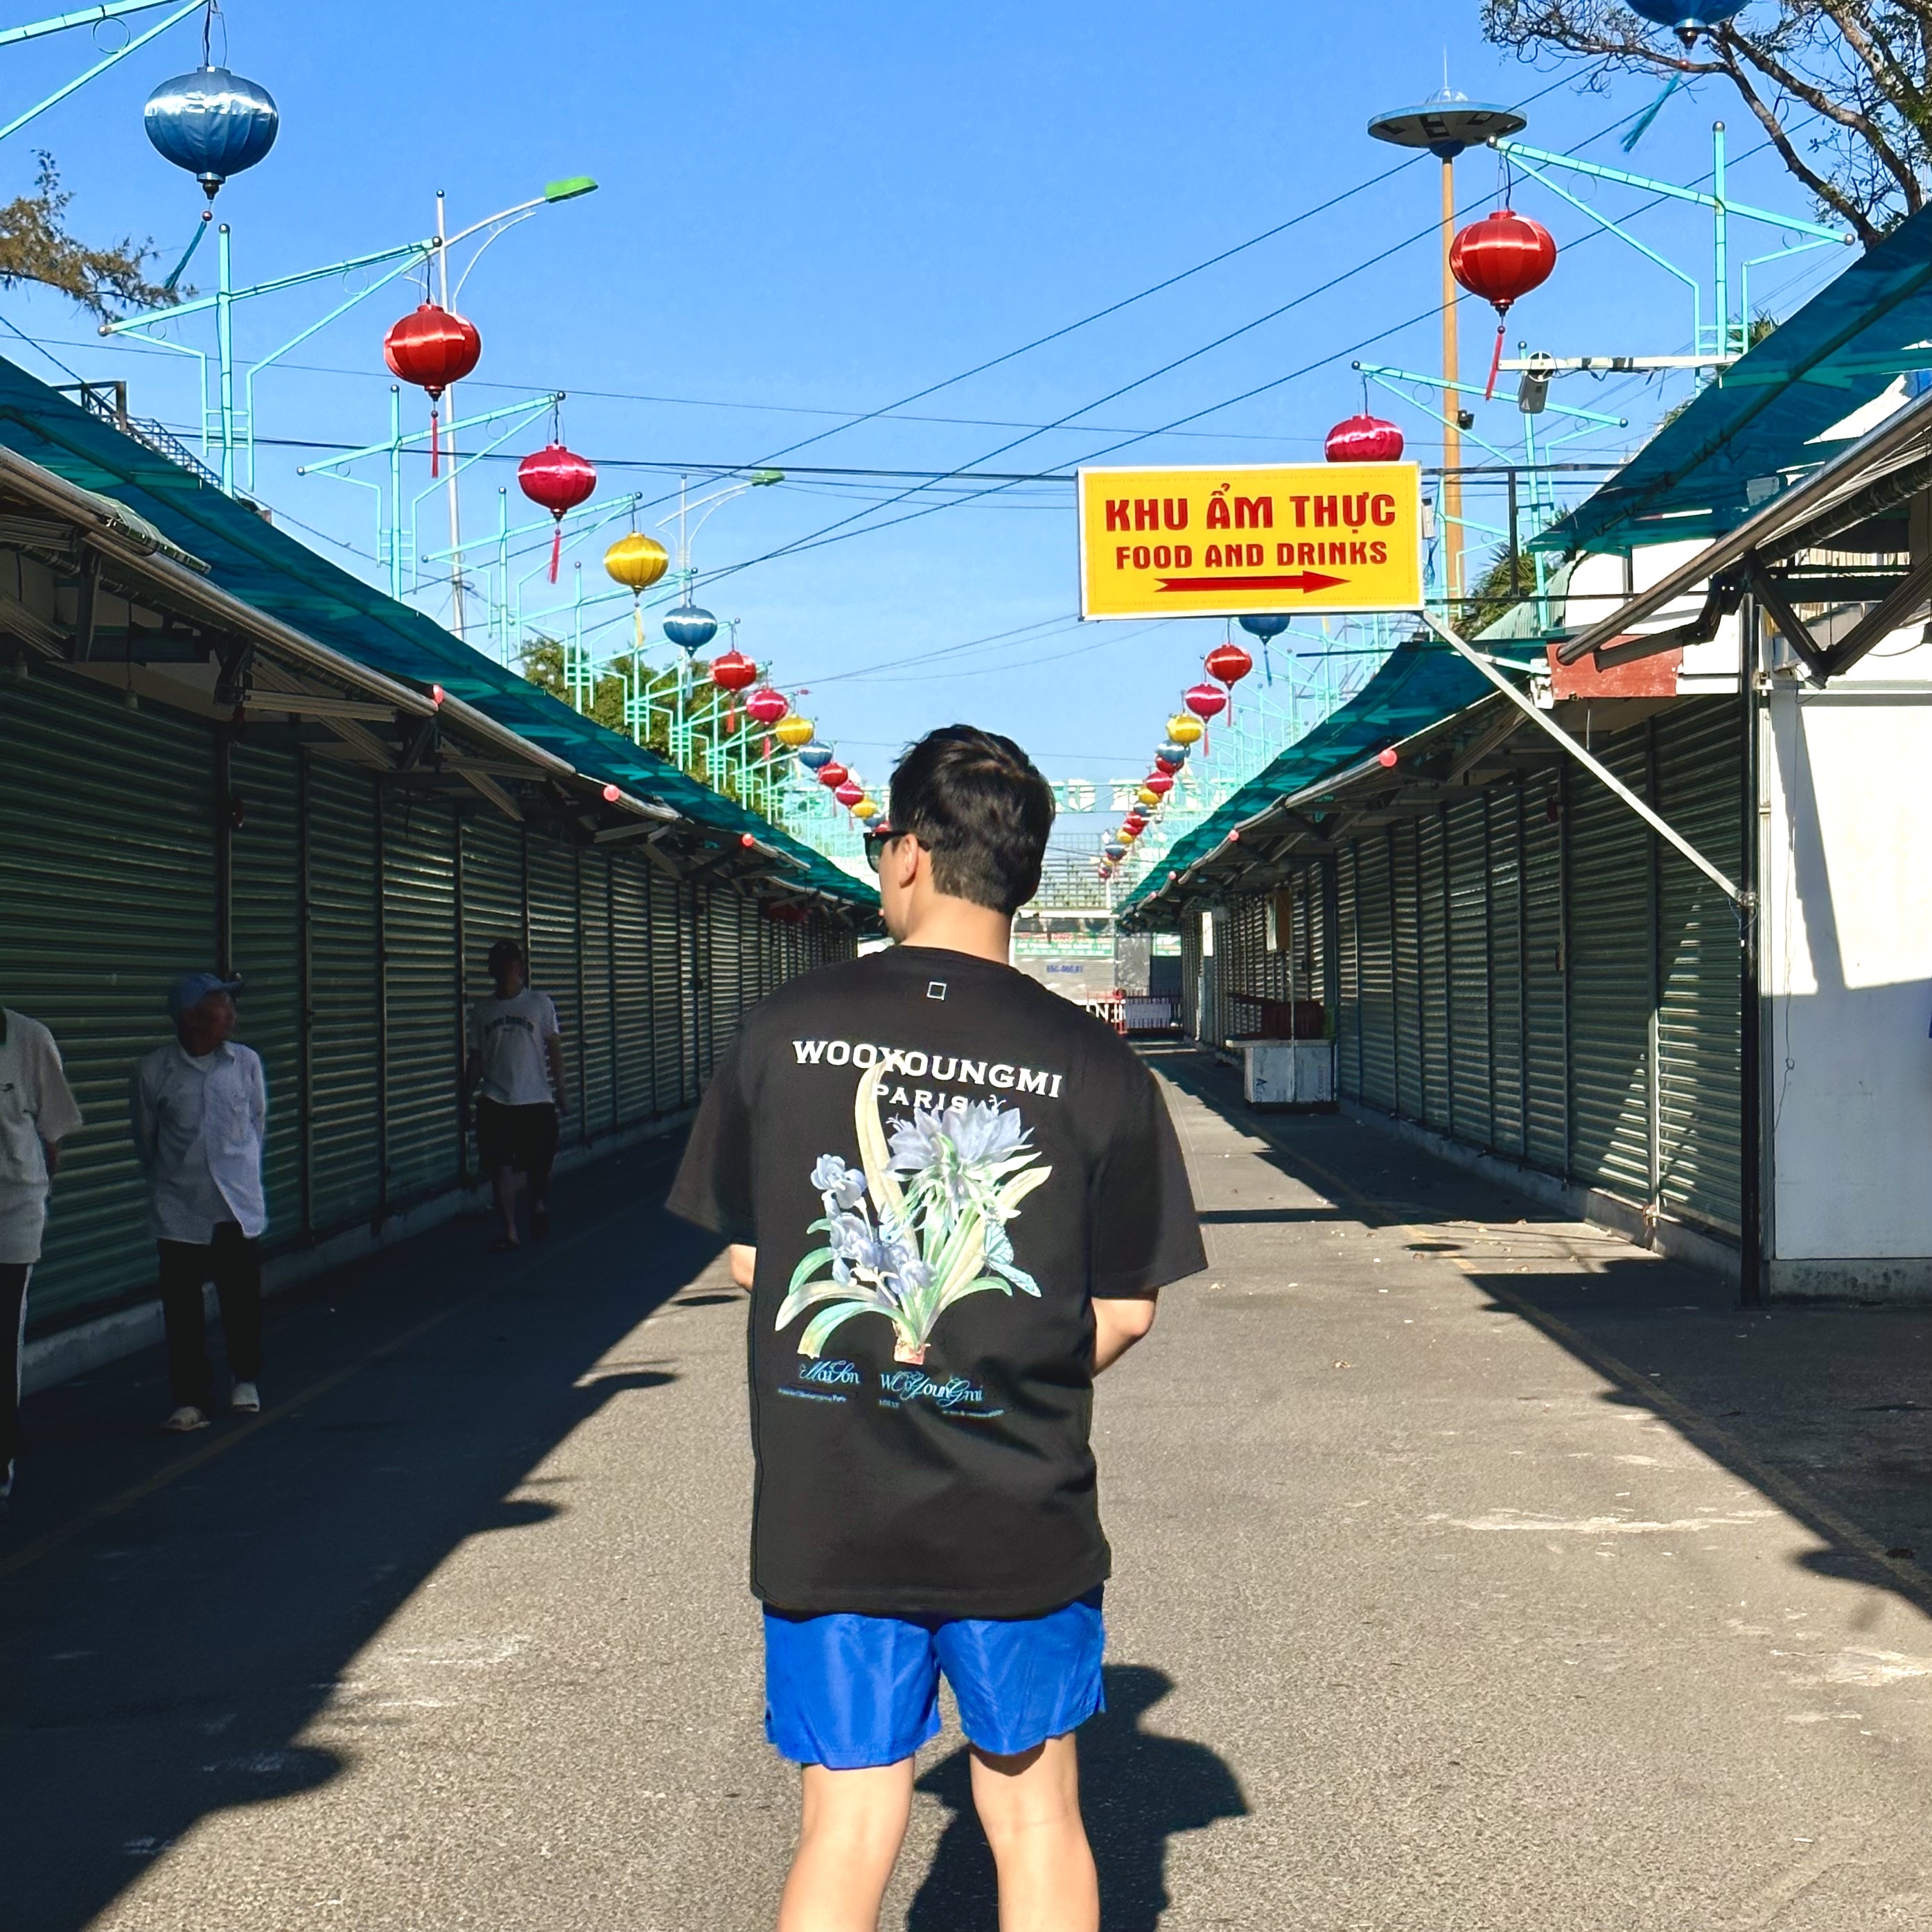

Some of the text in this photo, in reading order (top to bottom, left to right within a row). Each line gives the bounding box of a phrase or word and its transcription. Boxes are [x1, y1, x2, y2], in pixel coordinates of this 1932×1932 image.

[1106, 483, 1396, 534] KHU ẨM THỰC
[1116, 541, 1387, 570] FOOD AND DRINKS
[792, 1041, 1062, 1098] WOOYOUNGMI
[870, 1083, 969, 1114] PARIS
